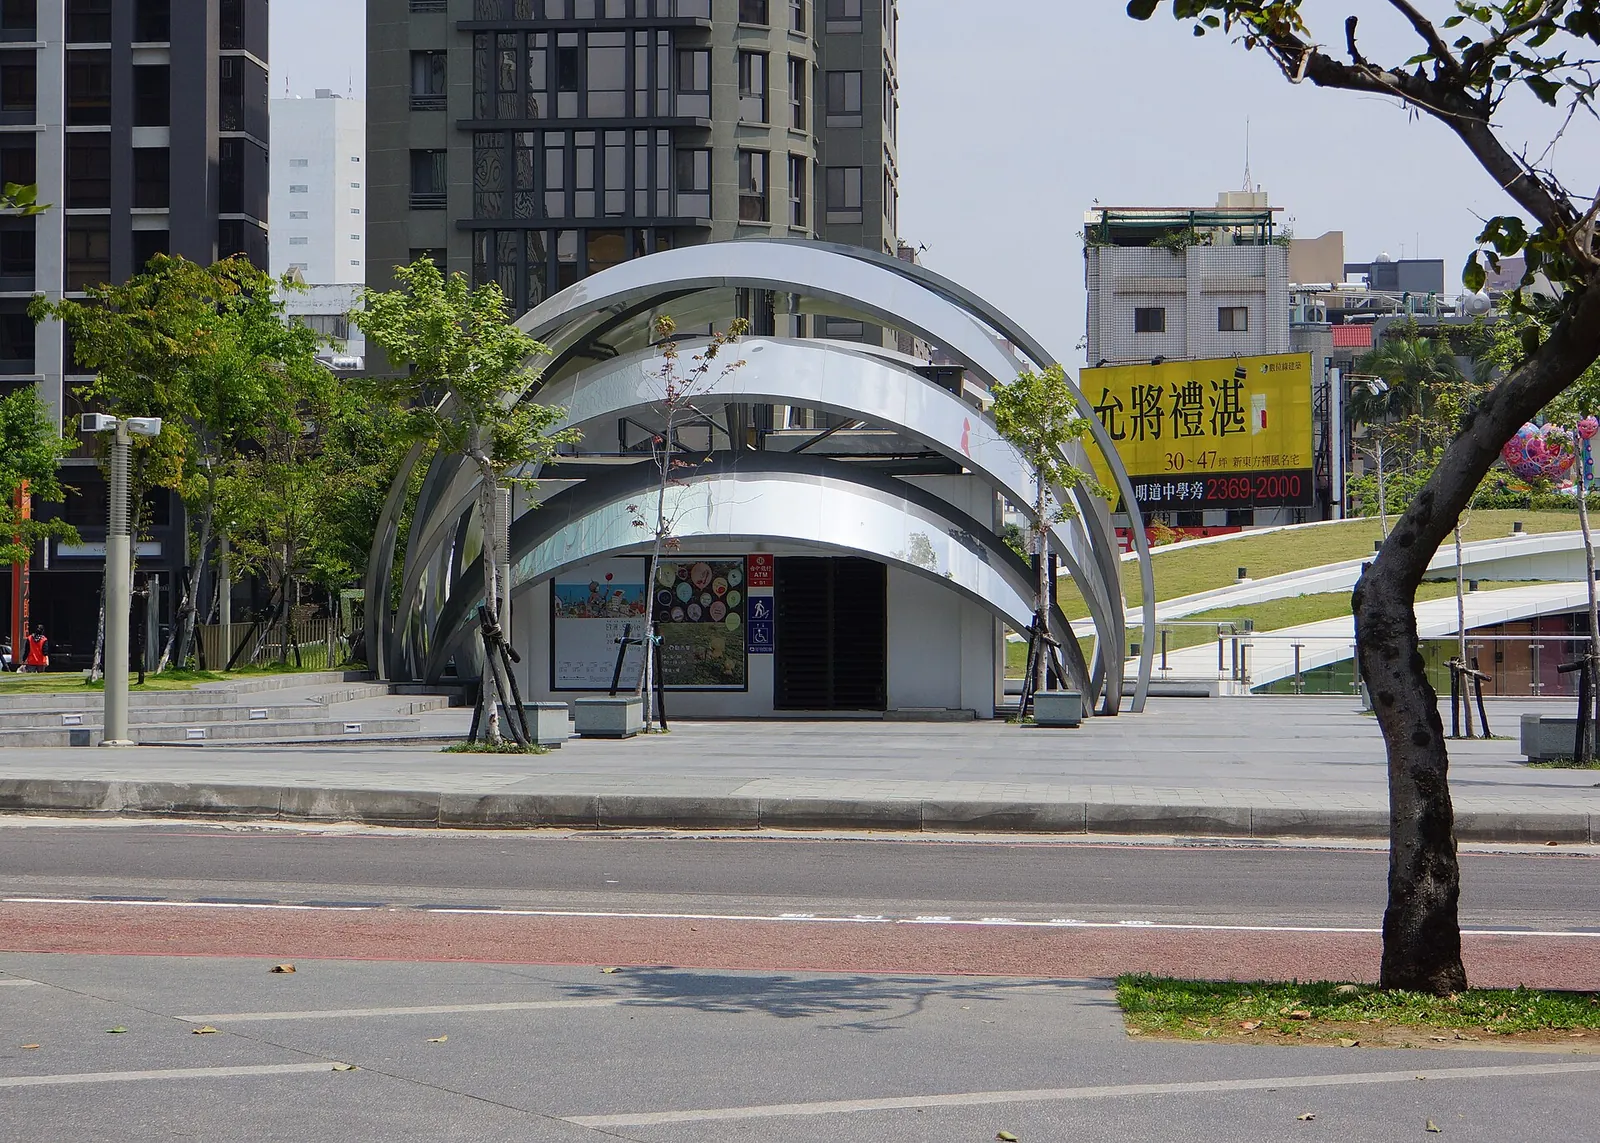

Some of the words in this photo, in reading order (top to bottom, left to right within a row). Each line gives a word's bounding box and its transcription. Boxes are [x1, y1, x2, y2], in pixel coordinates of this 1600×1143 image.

[1092, 378, 1246, 443] 允將禮湛
[1135, 481, 1204, 502] 明道中學旁
[1206, 475, 1301, 500] 2369-2000
